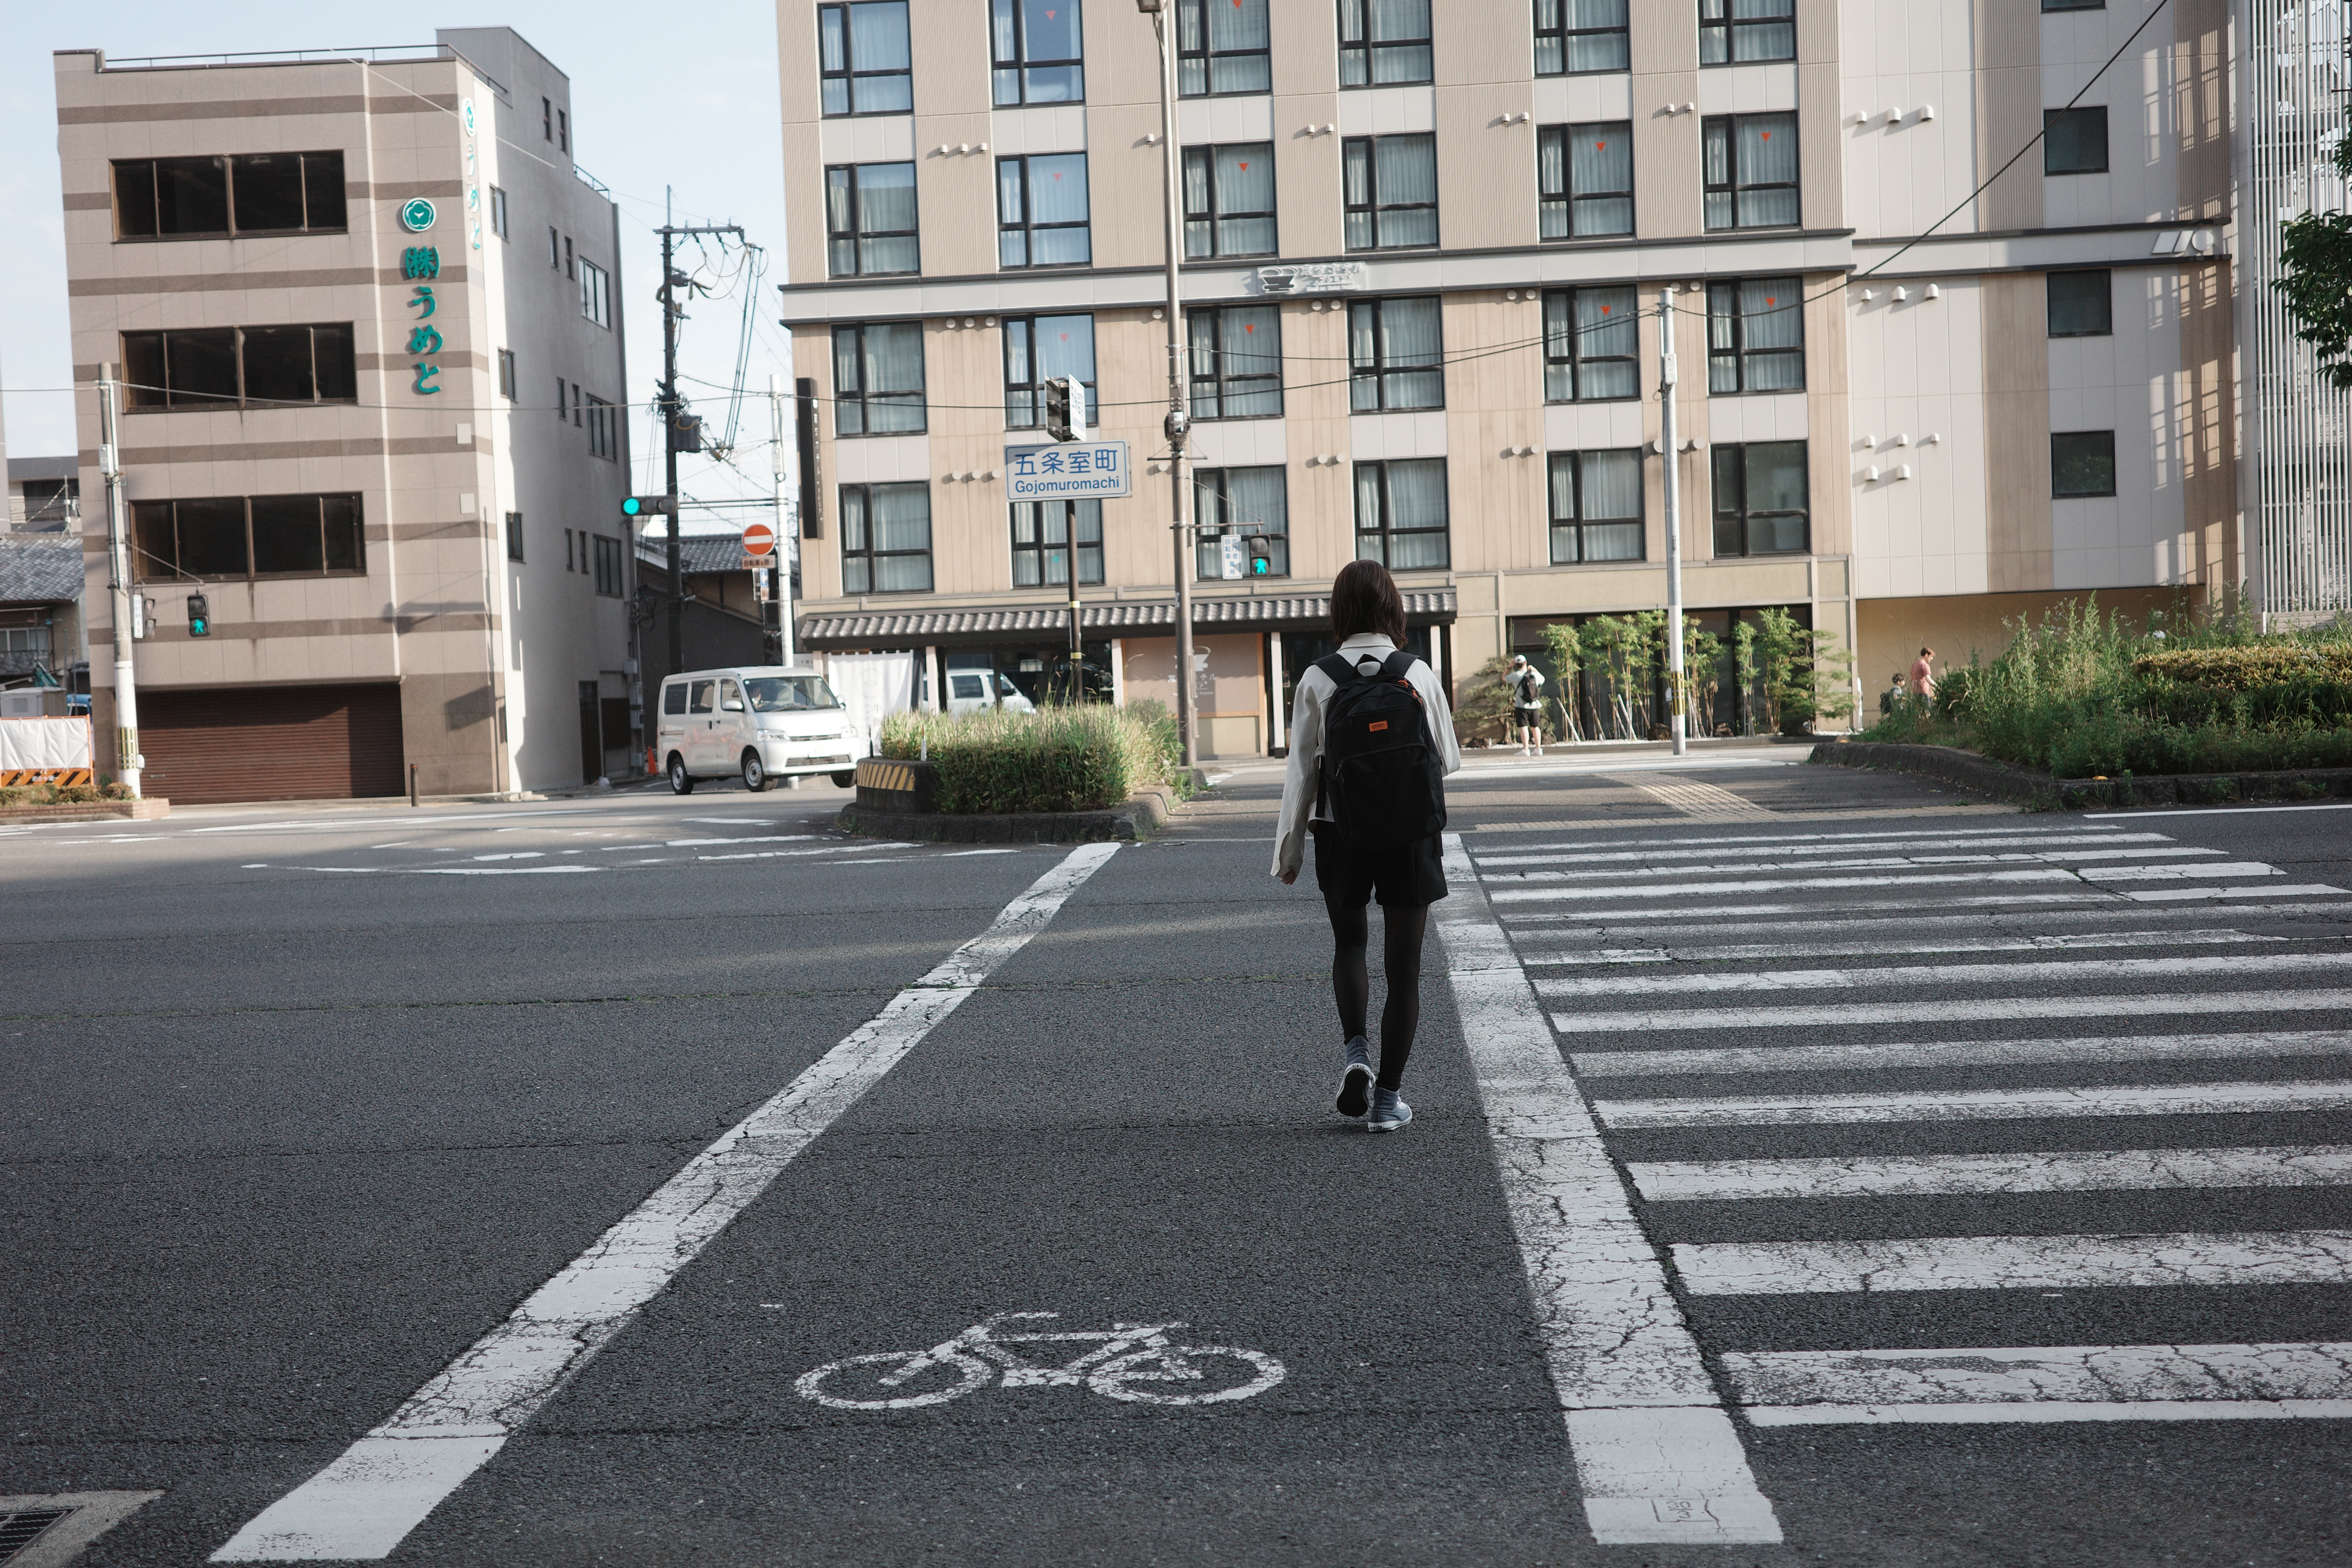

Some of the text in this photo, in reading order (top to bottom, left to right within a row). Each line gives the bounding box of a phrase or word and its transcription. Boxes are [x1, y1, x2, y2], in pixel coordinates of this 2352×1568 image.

[1014, 449, 1117, 475] 五条室町
[1015, 476, 1119, 494] Gojomuromachi
